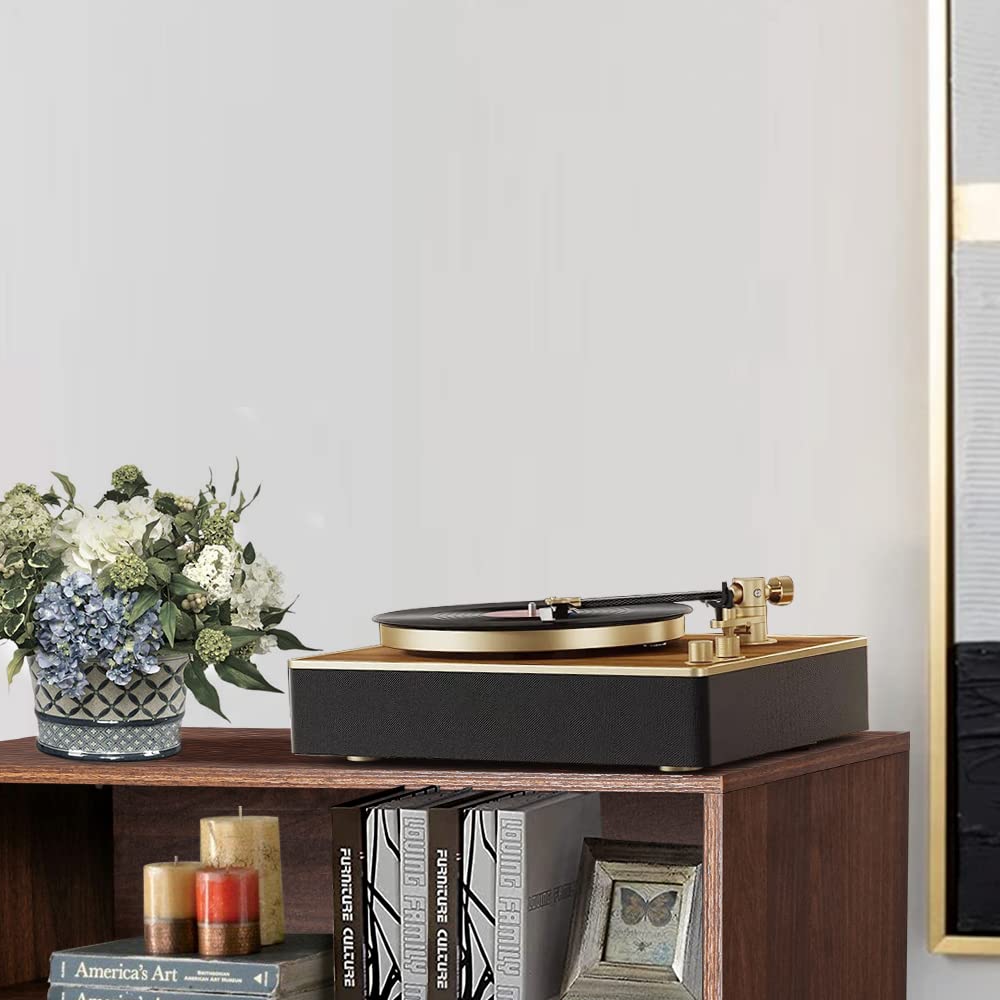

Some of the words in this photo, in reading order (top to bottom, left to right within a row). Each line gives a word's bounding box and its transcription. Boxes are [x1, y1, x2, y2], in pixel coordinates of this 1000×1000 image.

[342, 927, 356, 988] CULTURE
[404, 895, 426, 975] FAMILY
[436, 929, 448, 990] CULTURE
[498, 897, 521, 977] FAMILY
[74, 961, 149, 982] America's
[151, 965, 178, 983] Art
